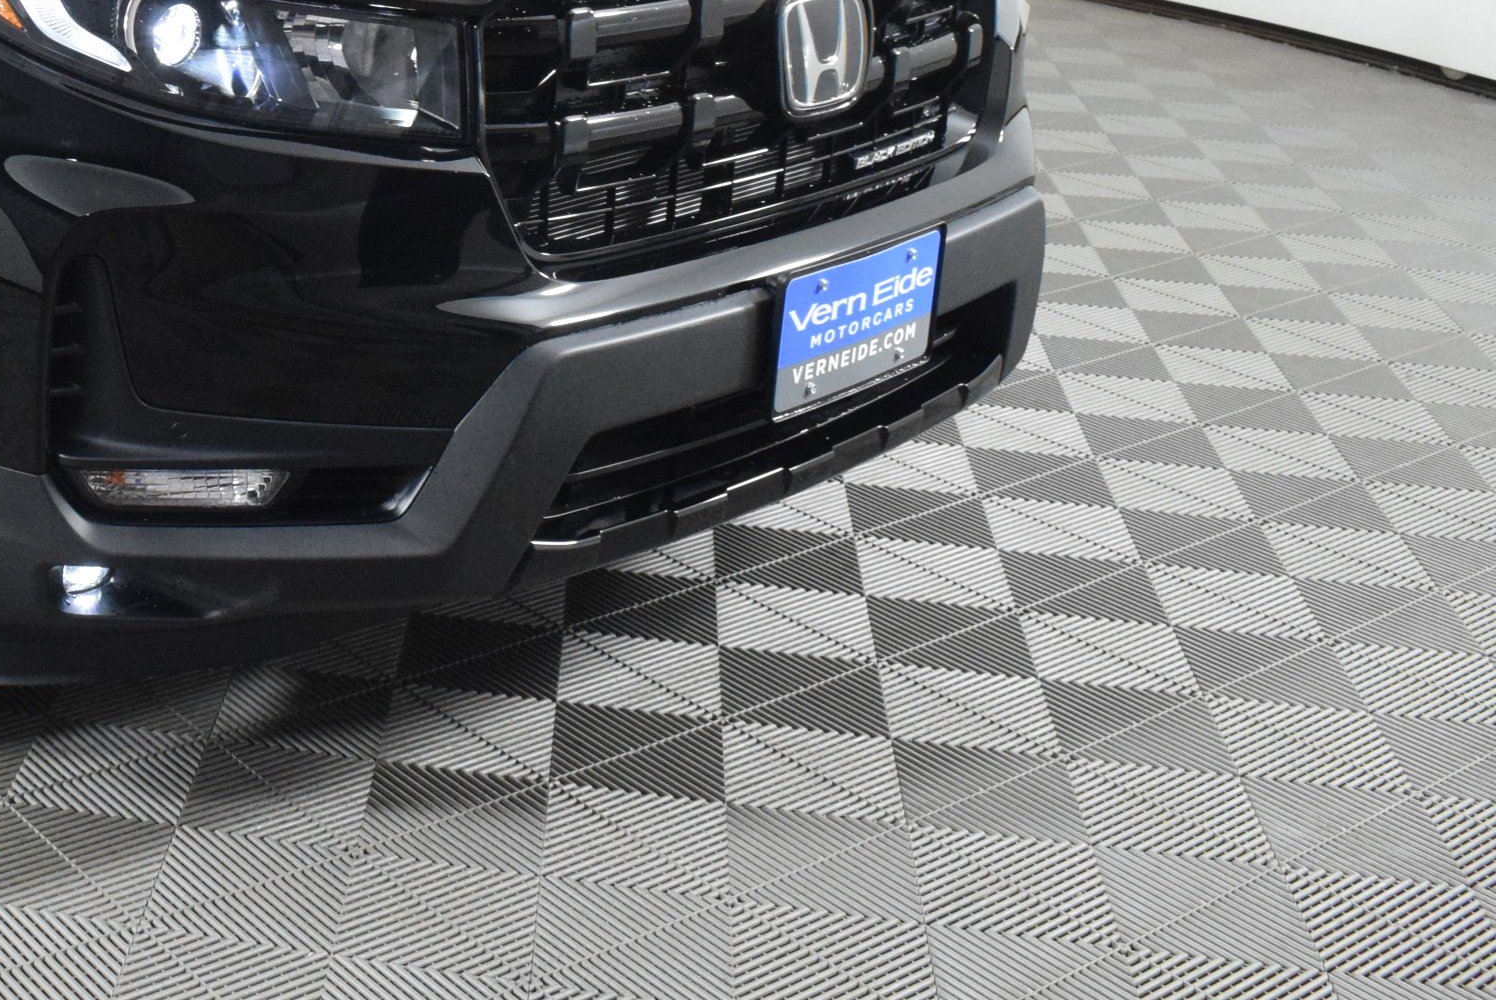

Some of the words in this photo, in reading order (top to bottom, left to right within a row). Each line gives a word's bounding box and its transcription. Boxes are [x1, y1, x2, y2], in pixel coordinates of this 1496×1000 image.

[789, 290, 867, 331] Vern
[871, 266, 933, 307] Eide
[810, 298, 914, 348] MOTORCARS
[792, 322, 916, 384] VERNEIDE.COM
